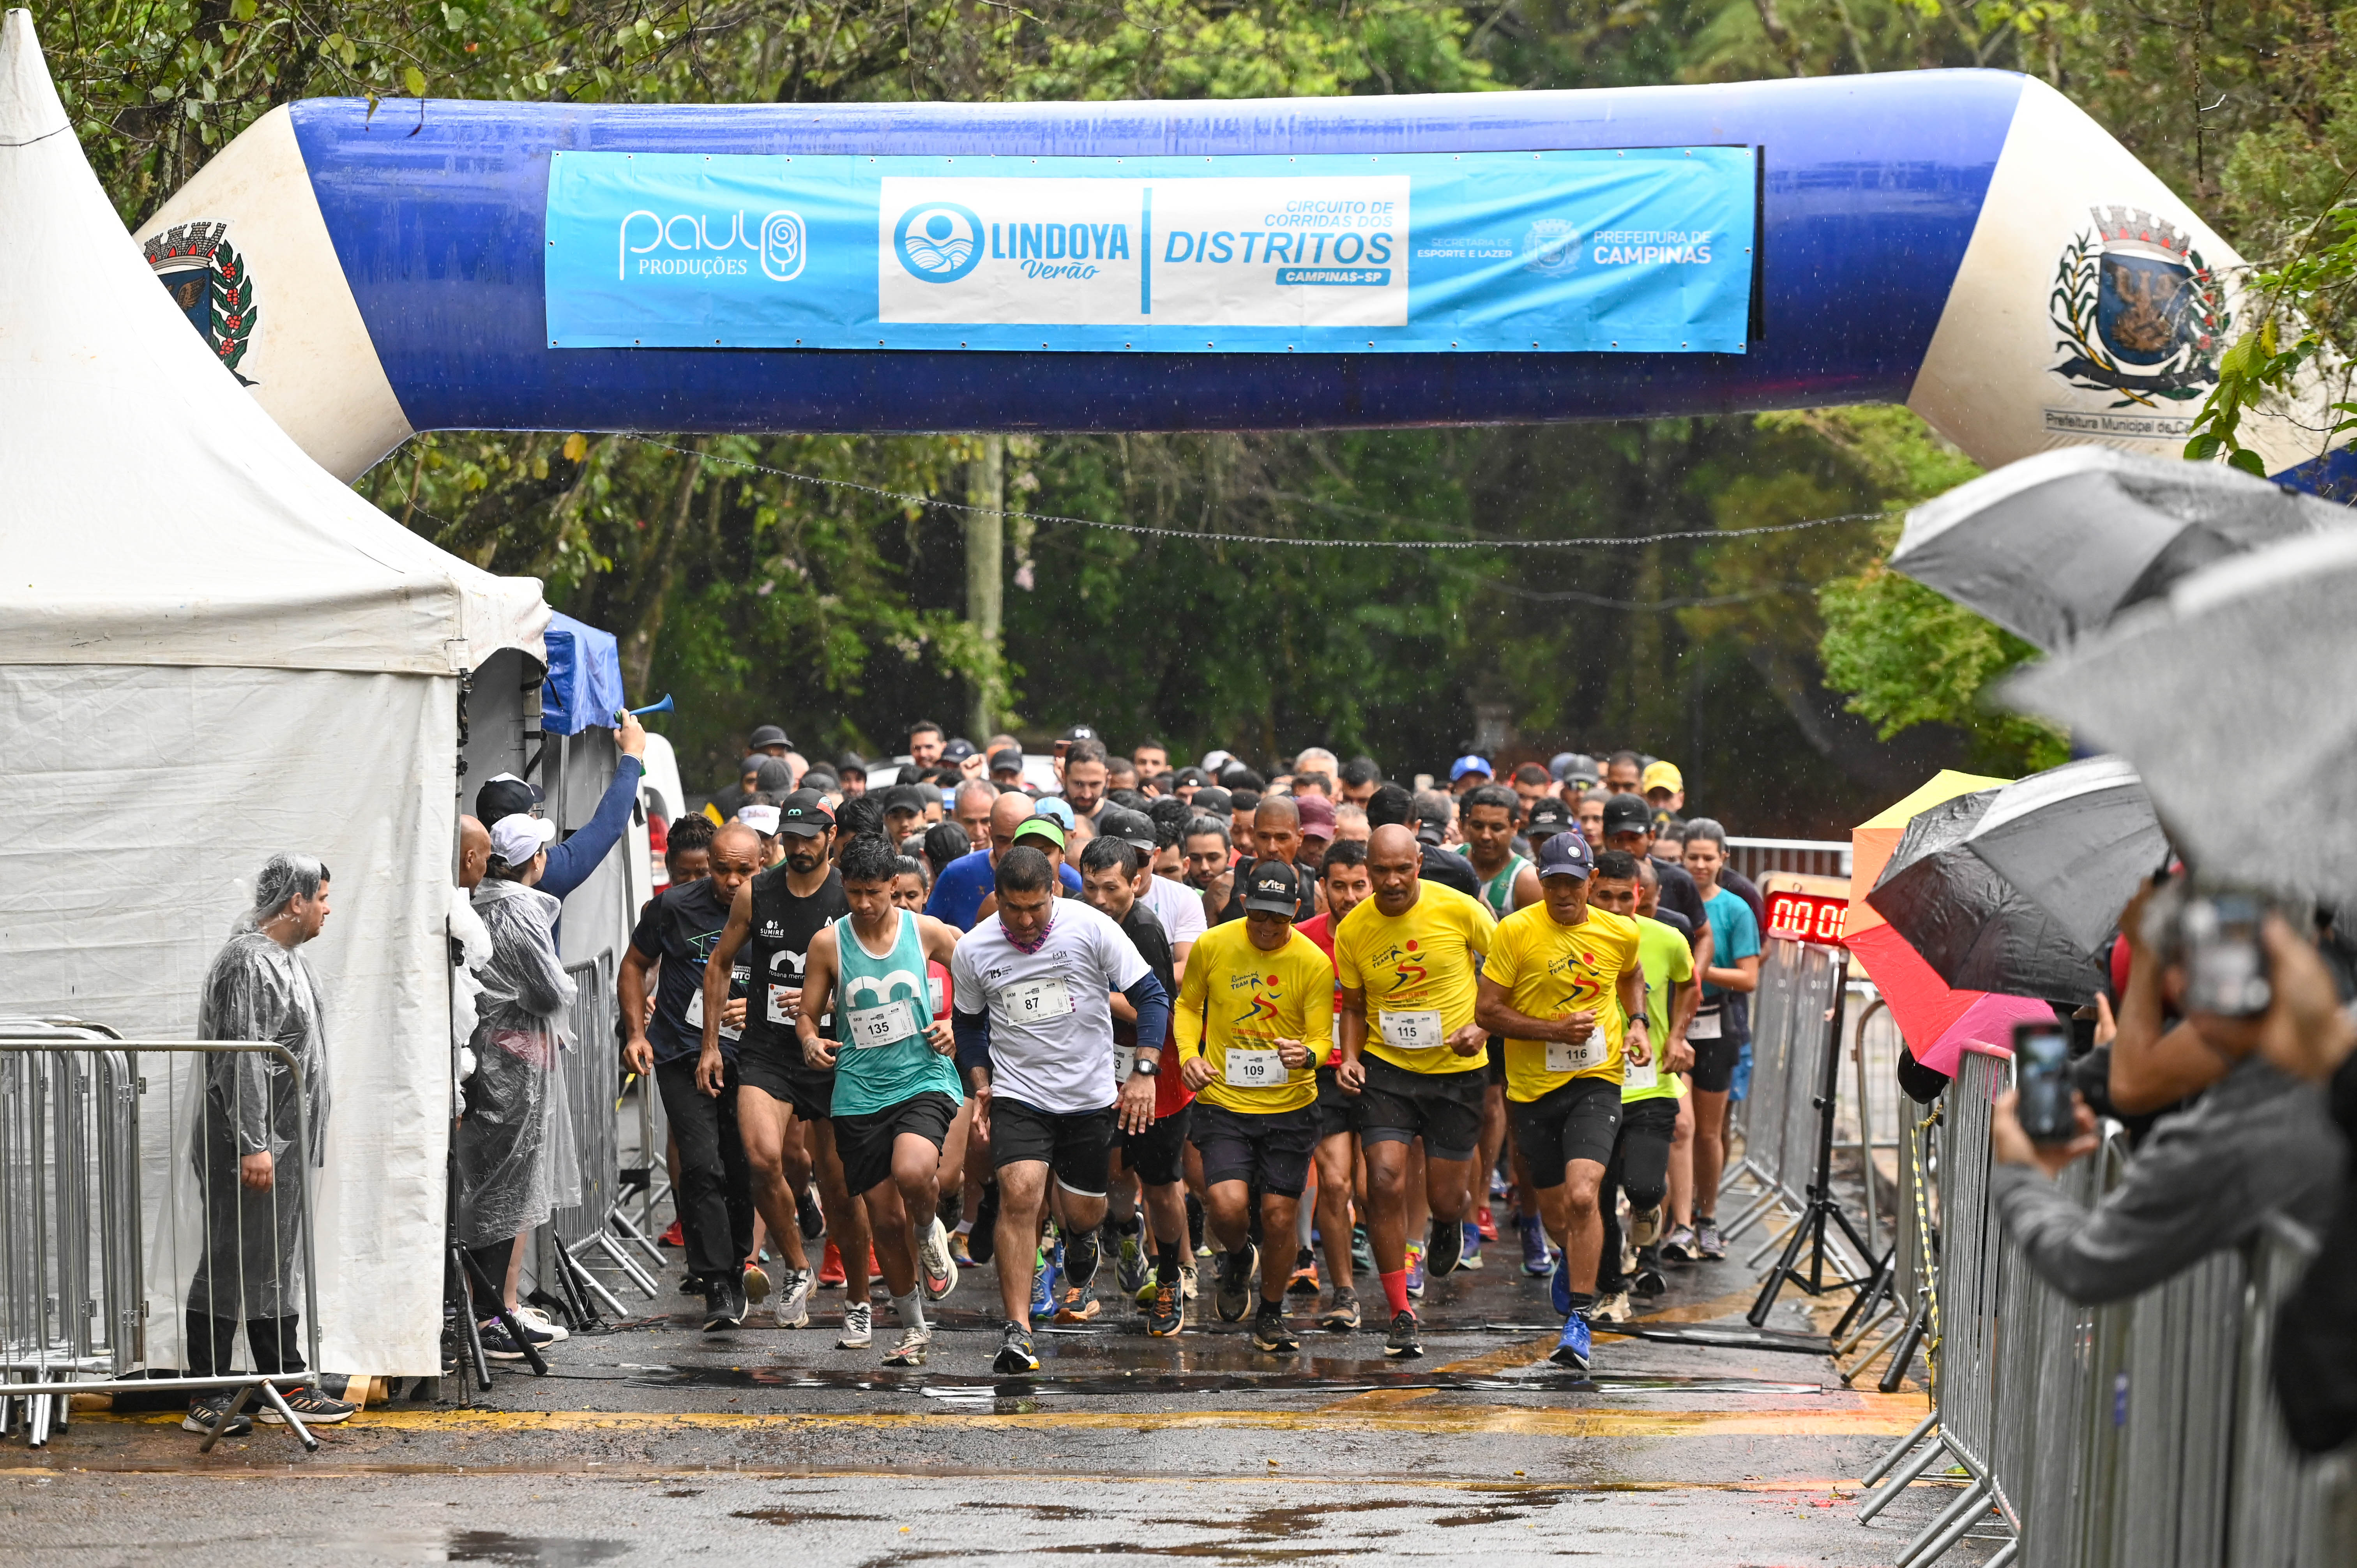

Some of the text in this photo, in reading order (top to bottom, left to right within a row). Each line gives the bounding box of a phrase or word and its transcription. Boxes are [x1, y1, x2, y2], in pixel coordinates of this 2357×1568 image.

[1286, 201, 1394, 214] CIRCUITO DE
[1265, 214, 1393, 228] CORRIDAS DOS
[991, 222, 1130, 260] LINDOYA
[1431, 238, 1512, 247] SECRETARIA DE
[1594, 231, 1711, 244] PREFEITURA DE
[1164, 231, 1393, 264] DISTRITOS
[1417, 249, 1513, 258] ESPORTE E LAZER
[1594, 245, 1712, 265] CAMPINAS
[638, 256, 747, 279] PRODUÇÕES
[1020, 259, 1101, 280] Verão
[1285, 271, 1382, 283] CAMPINAS-SP
[2045, 413, 2098, 429] Prefeitura
[2101, 417, 2155, 433] Municipal
[1373, 955, 1389, 969] TEAM
[769, 969, 787, 978] rosana
[1548, 963, 1566, 975] TEAM
[1230, 980, 1249, 990] TEAM
[1025, 997, 1039, 1010] 87
[868, 1022, 889, 1035] 135
[1397, 1027, 1417, 1037] 115
[1566, 1049, 1587, 1059] 116
[1243, 1065, 1264, 1075] 109
